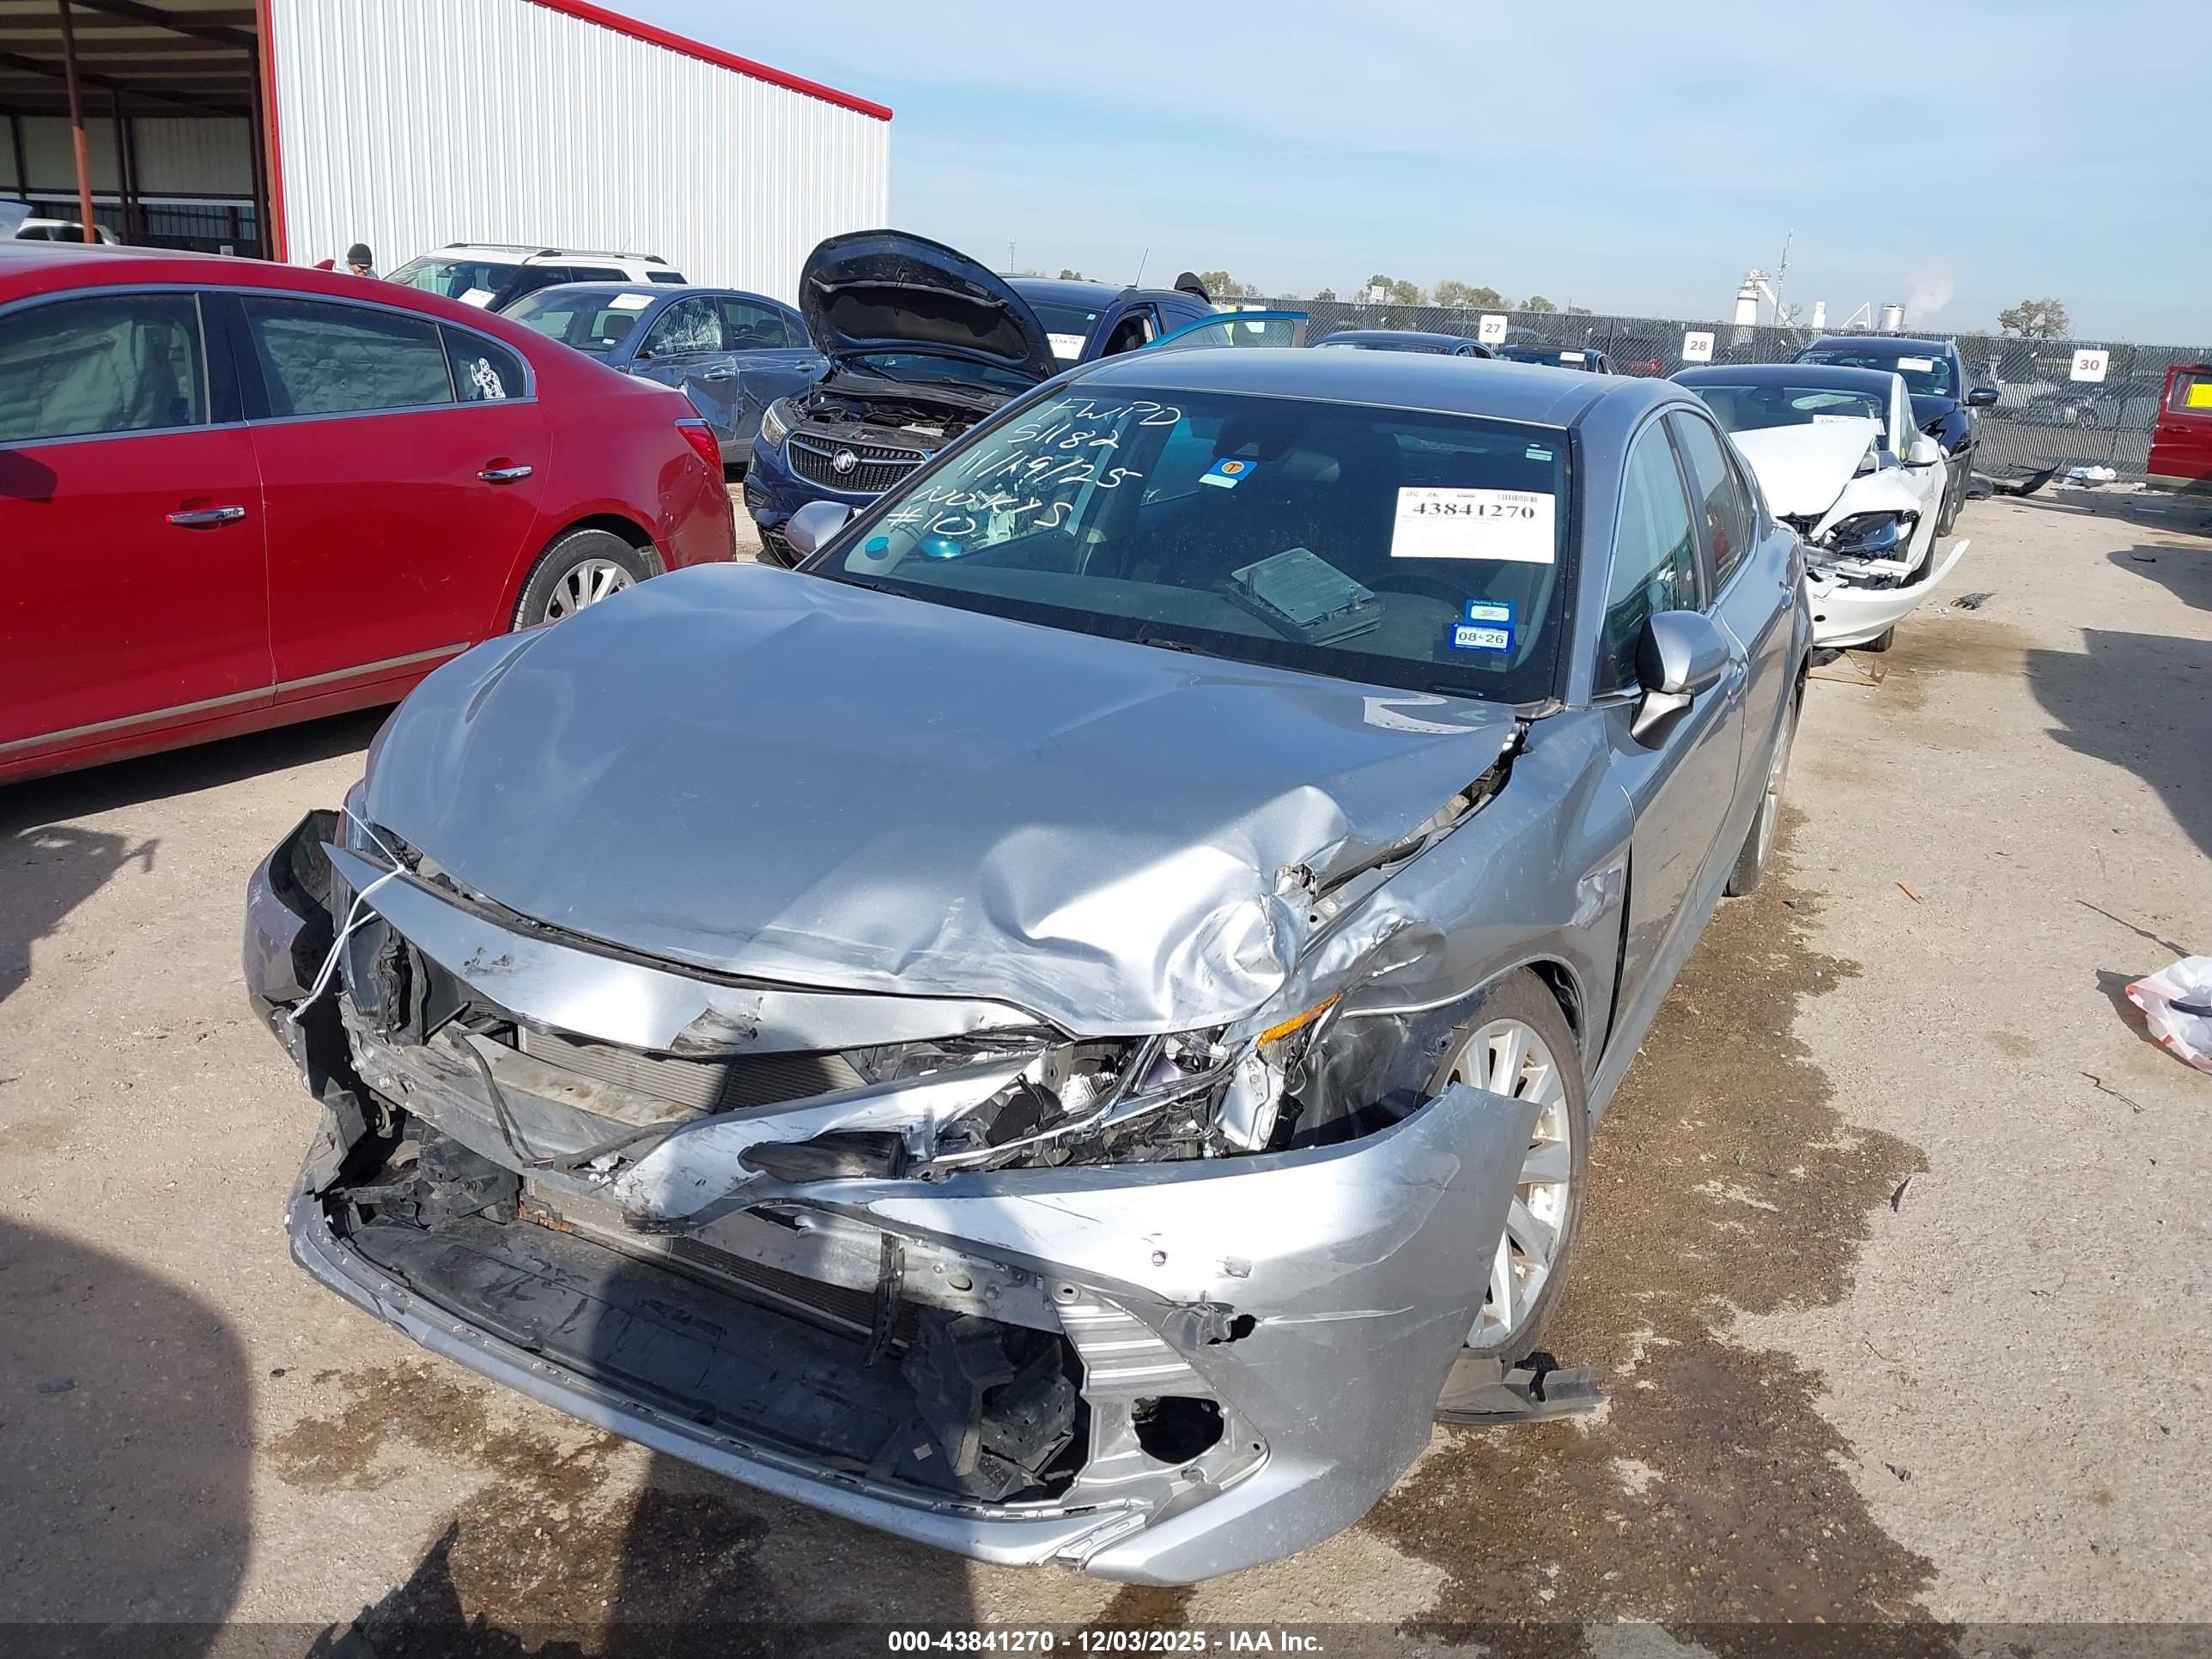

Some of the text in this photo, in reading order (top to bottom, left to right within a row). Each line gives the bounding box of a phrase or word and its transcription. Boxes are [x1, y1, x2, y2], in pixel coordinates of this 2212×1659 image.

[1485, 323, 1501, 334] 27
[1689, 340, 1708, 351] 28
[2079, 359, 2100, 371] 30
[1412, 502, 1535, 520] 43841270
[886, 505, 977, 536] #10
[1458, 631, 1504, 645] 08 26
